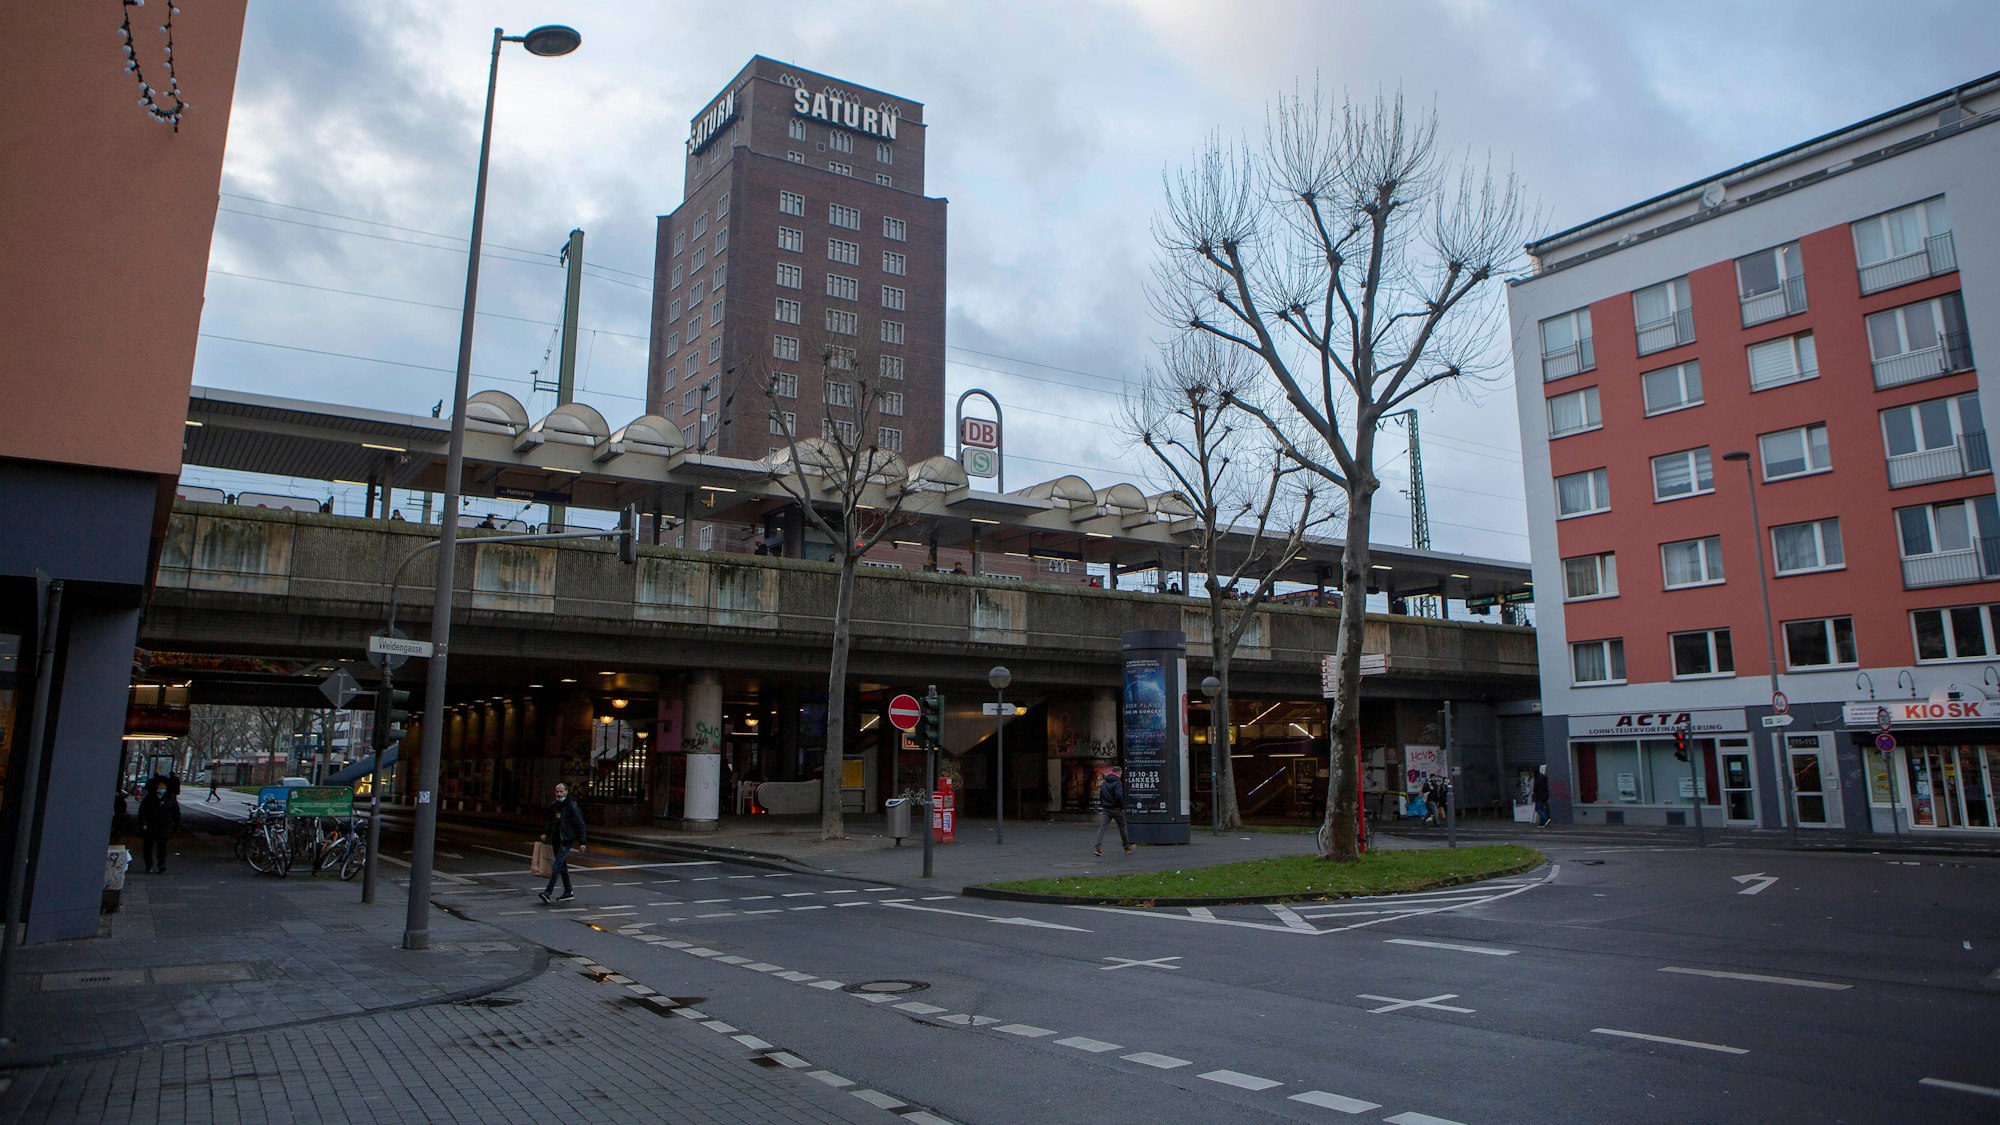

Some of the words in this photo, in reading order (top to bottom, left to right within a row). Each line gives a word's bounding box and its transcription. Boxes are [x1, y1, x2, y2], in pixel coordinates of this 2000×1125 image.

[688, 89, 735, 155] SATURN
[793, 87, 897, 140] SATURN
[969, 422, 994, 443] DB
[378, 638, 423, 654] Weidengasse
[1905, 702, 1981, 719] KIOSK
[1616, 712, 1692, 727] ACTA
[1589, 724, 1723, 735] LOHNSTEUERVORFINANZERUNG
